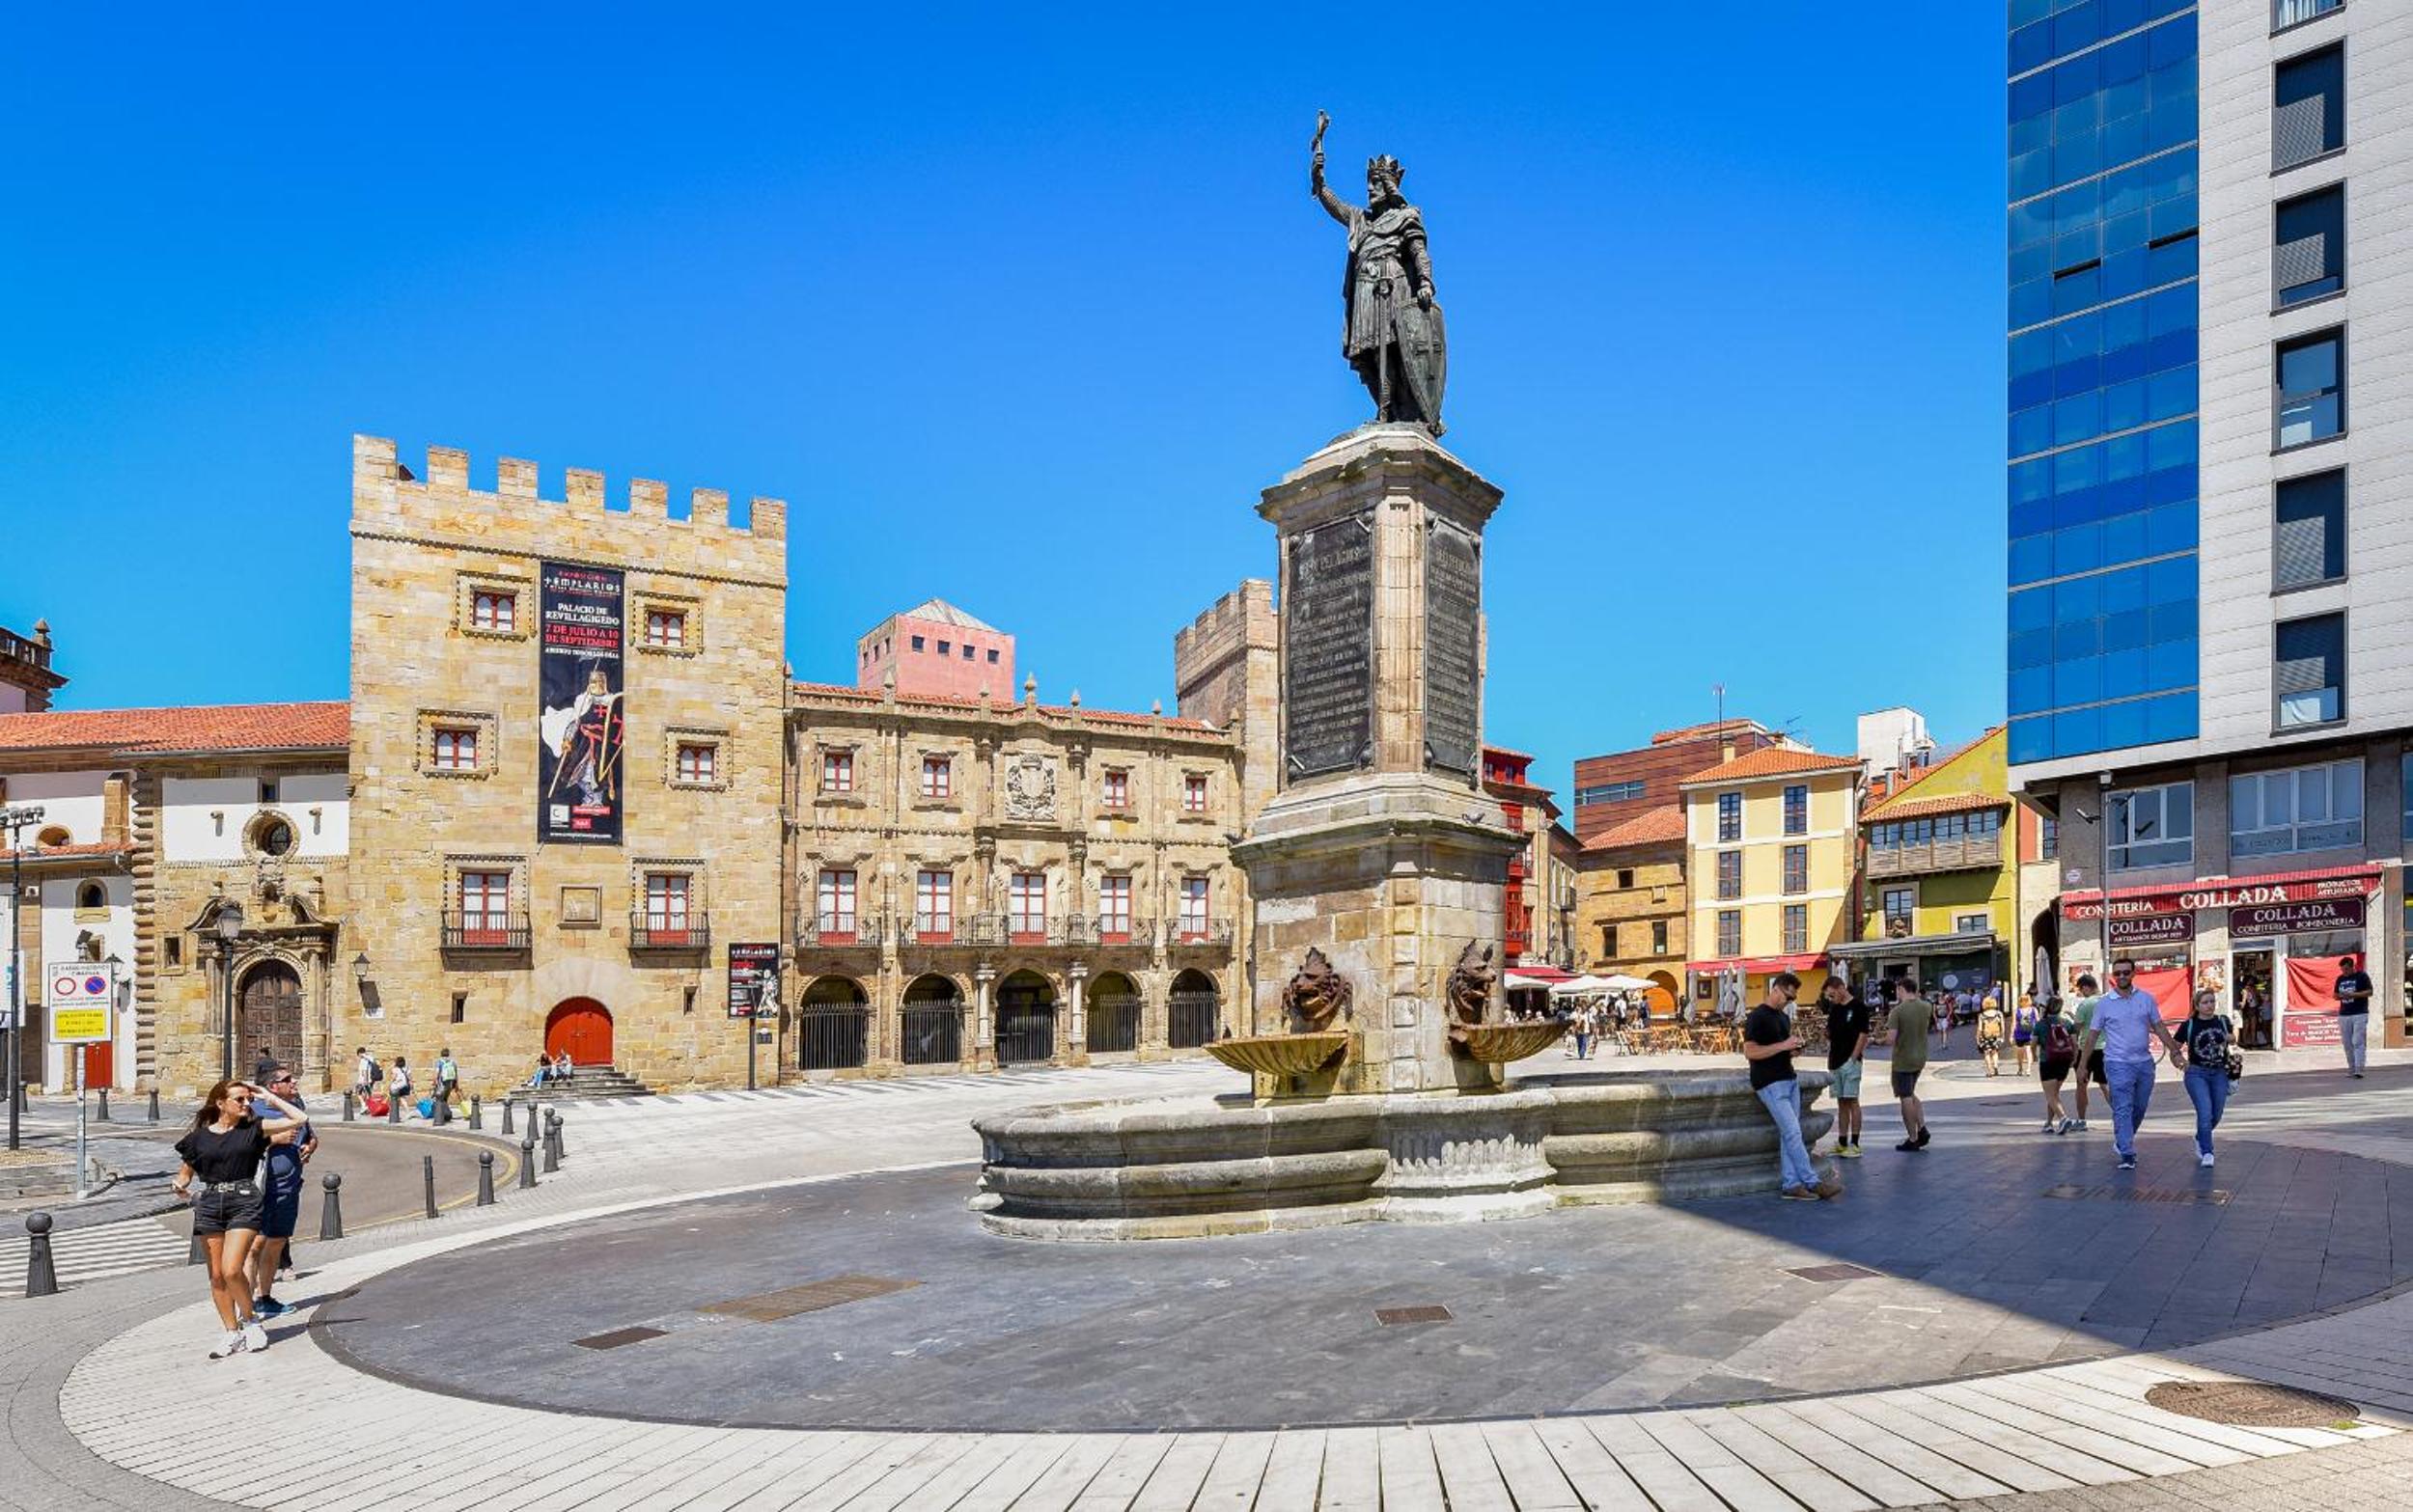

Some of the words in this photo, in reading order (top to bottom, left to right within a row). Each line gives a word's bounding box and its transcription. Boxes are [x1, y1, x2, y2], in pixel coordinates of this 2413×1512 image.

[558, 603, 595, 615] PALACIO
[596, 606, 608, 615] DE
[545, 611, 620, 625] REVILLAGIGEDO
[553, 625, 568, 635] DE
[569, 626, 597, 637] JULIO
[599, 629, 606, 638] A
[545, 634, 559, 644] DE
[560, 636, 619, 648] SEPTIEMBRE
[2317, 879, 2362, 890] PRODUCTOS
[2317, 886, 2364, 896] ASTURIANOS
[2179, 885, 2288, 910] COLLADA
[2255, 903, 2337, 922] COLLADA
[2110, 918, 2185, 935] COLLADA
